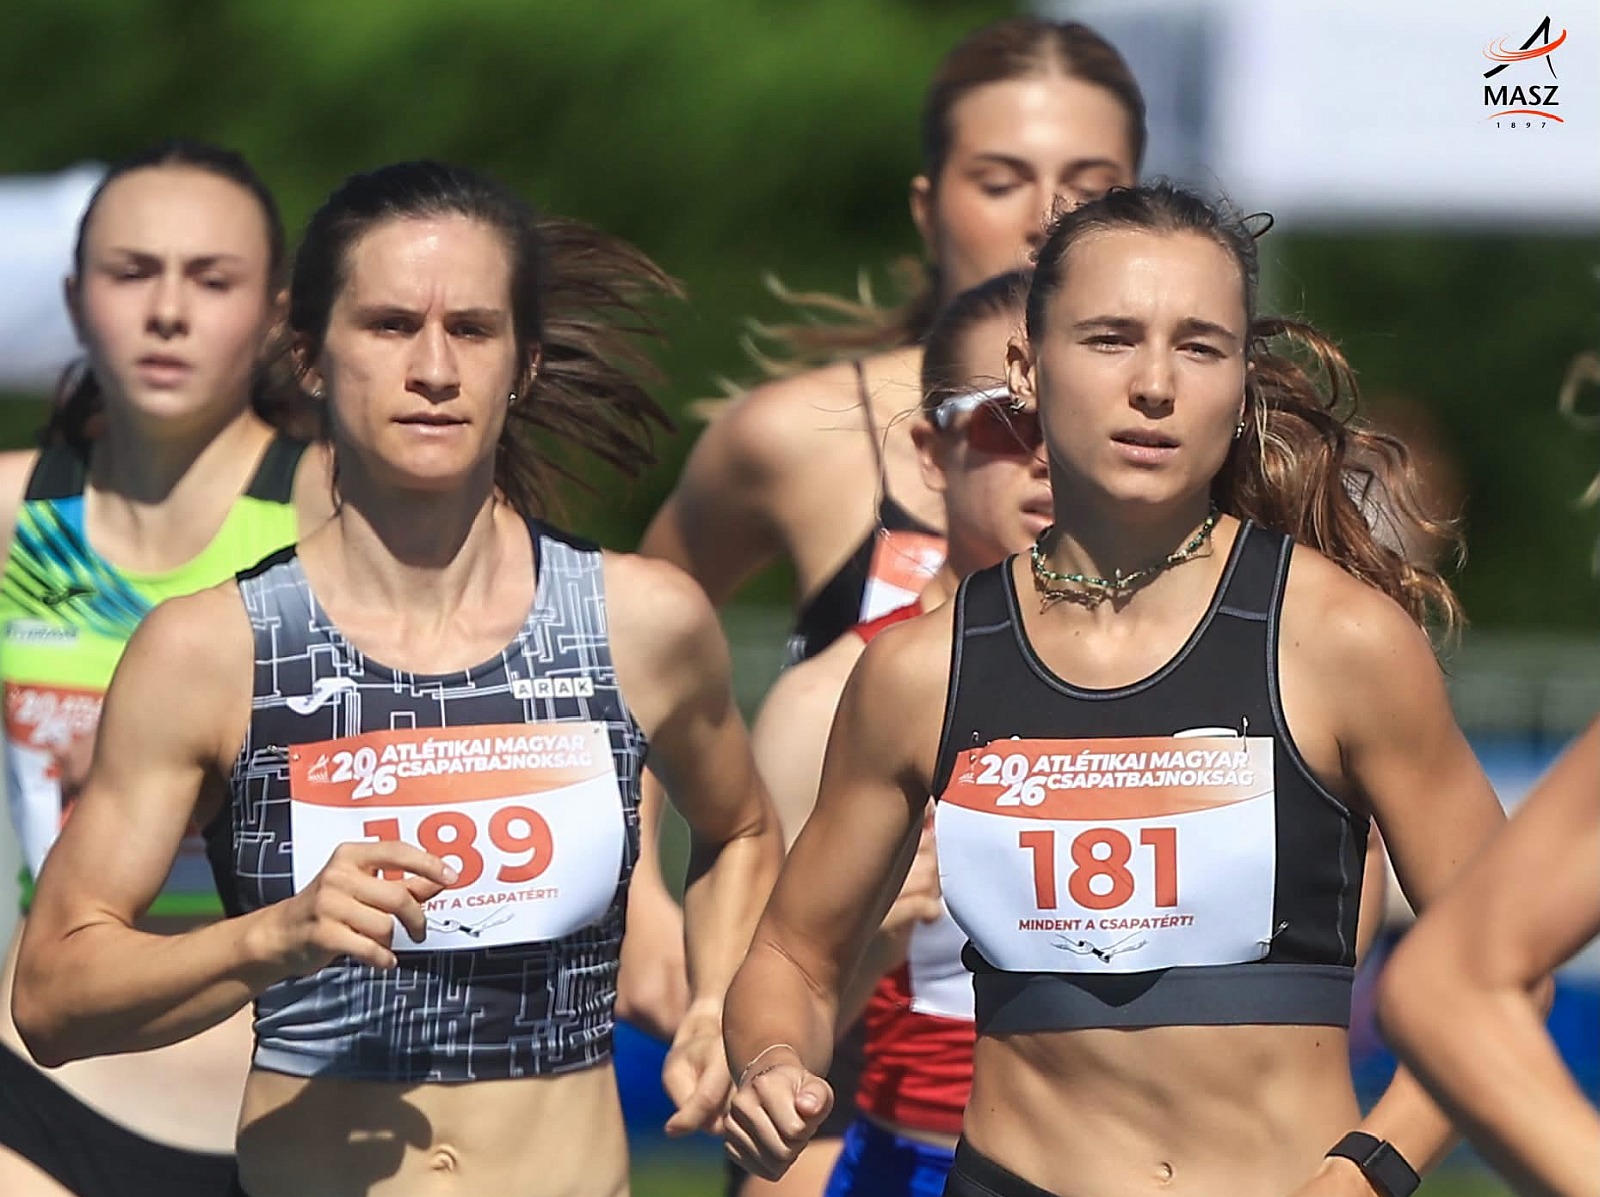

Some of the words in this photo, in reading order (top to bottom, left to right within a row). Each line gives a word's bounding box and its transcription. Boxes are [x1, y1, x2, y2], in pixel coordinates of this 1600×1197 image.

[518, 680, 588, 694] ARAK
[331, 746, 377, 783] 20
[381, 737, 491, 763] ATLÉTIKAI
[495, 734, 584, 755] MAGYAR
[976, 753, 1029, 785] 20
[1031, 750, 1146, 773] ATLÉTIKAI
[1149, 750, 1248, 771] MAGYAR
[351, 764, 397, 800] 26
[995, 775, 1048, 806] 26
[364, 805, 554, 890] 189
[1018, 827, 1178, 910] 181
[451, 899, 462, 909] A
[466, 888, 559, 907] CSAPATÉRT!
[1018, 919, 1082, 931] MINDENT
[1085, 919, 1095, 930] A
[1100, 914, 1195, 930] CSAPATÉRT!
